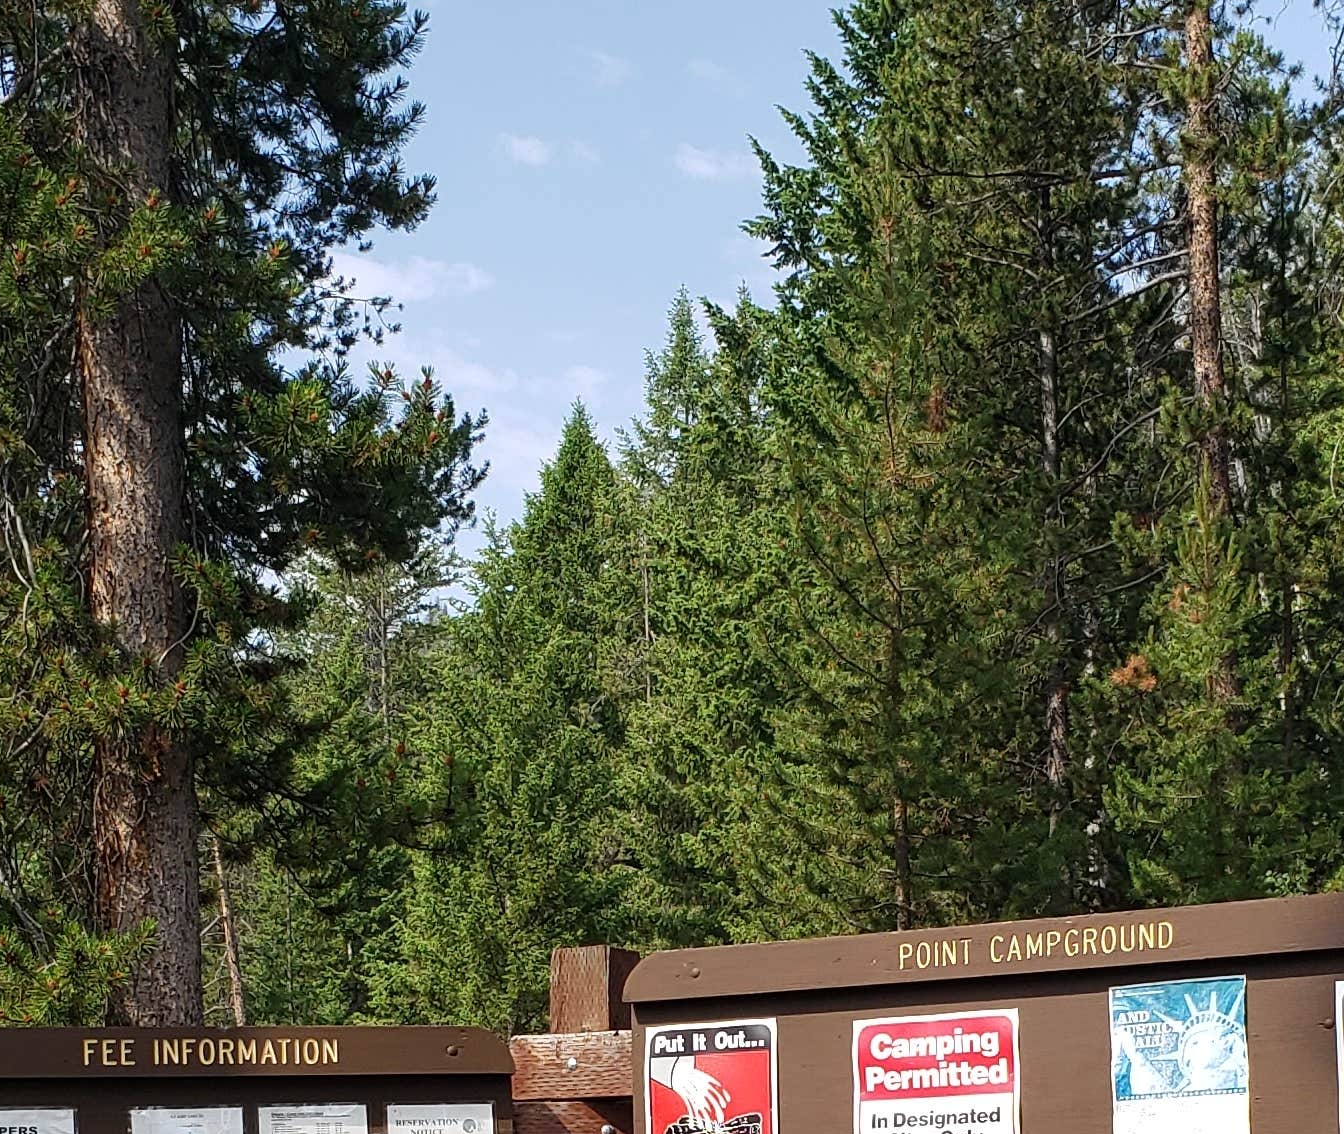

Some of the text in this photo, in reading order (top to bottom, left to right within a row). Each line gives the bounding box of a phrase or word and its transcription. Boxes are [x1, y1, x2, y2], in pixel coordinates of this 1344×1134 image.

[898, 921, 1174, 970] POINT CAMPGROUND
[82, 1038, 339, 1066] FEE INFORMATION
[654, 1031, 764, 1053] Put It Out...
[870, 1027, 999, 1060] Camping
[865, 1058, 1007, 1092] Permitted
[872, 1107, 1000, 1128] In Designated
